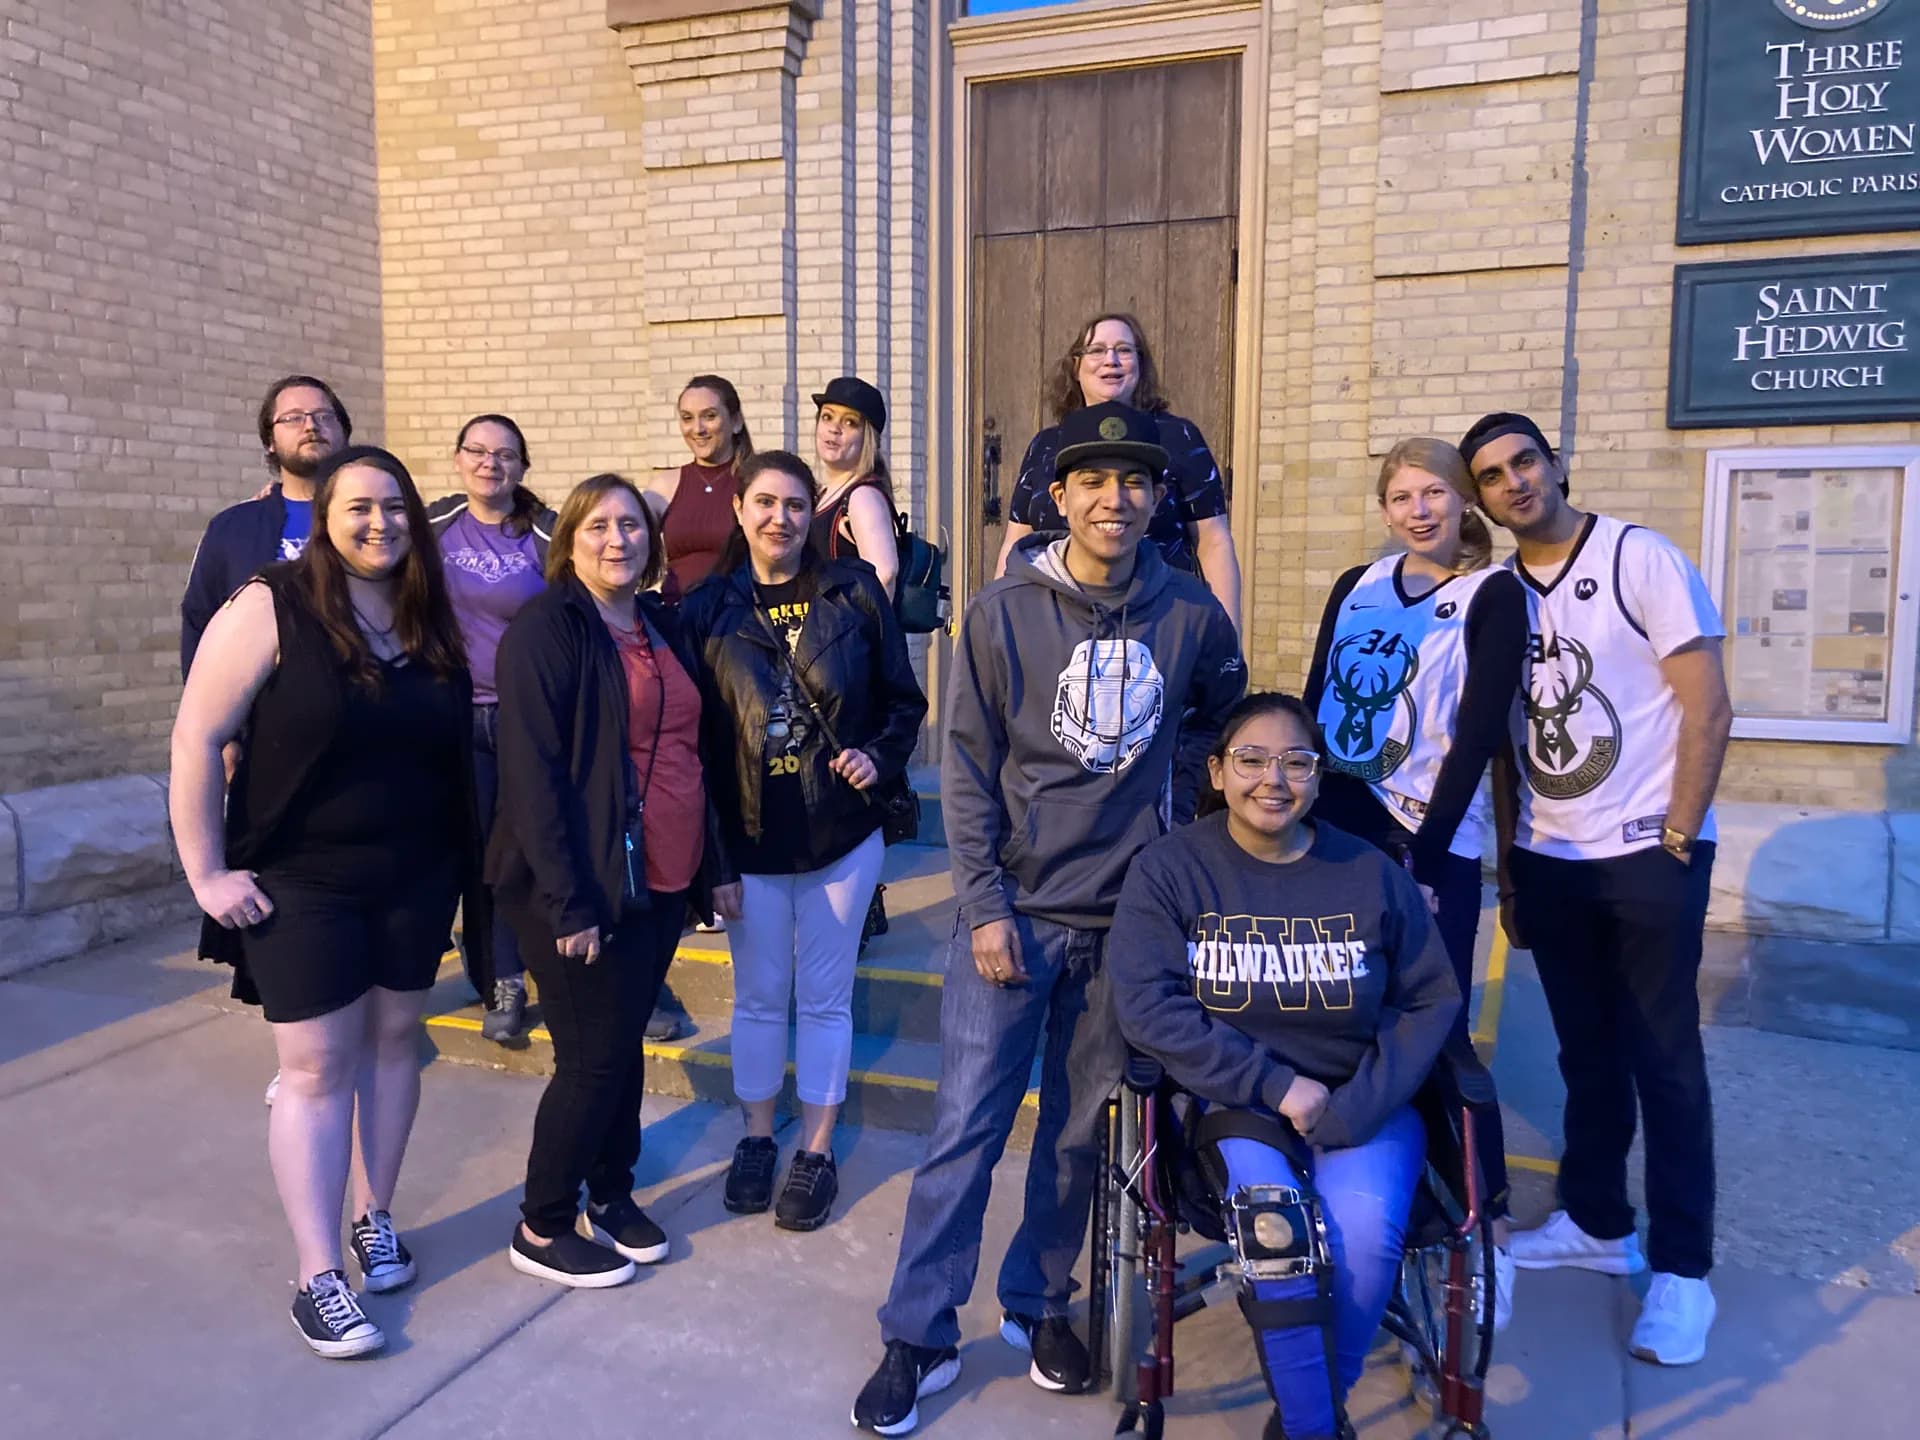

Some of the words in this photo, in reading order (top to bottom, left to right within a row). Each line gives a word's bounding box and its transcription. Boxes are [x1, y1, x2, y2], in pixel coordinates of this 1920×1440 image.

[1766, 40, 1902, 79] THREE
[1774, 81, 1891, 120] HOLY
[1749, 124, 1915, 165] WOMEN
[1721, 178, 1842, 203] CATHOLIC
[1755, 282, 1888, 324] SAINT
[1732, 320, 1907, 361] HEDWIG
[1751, 366, 1885, 390] CHURCH
[1358, 629, 1402, 658] 34
[1576, 738, 1614, 786] BUCKS
[1187, 940, 1370, 982] MILWAUKEE
[1197, 912, 1355, 1012] UW
